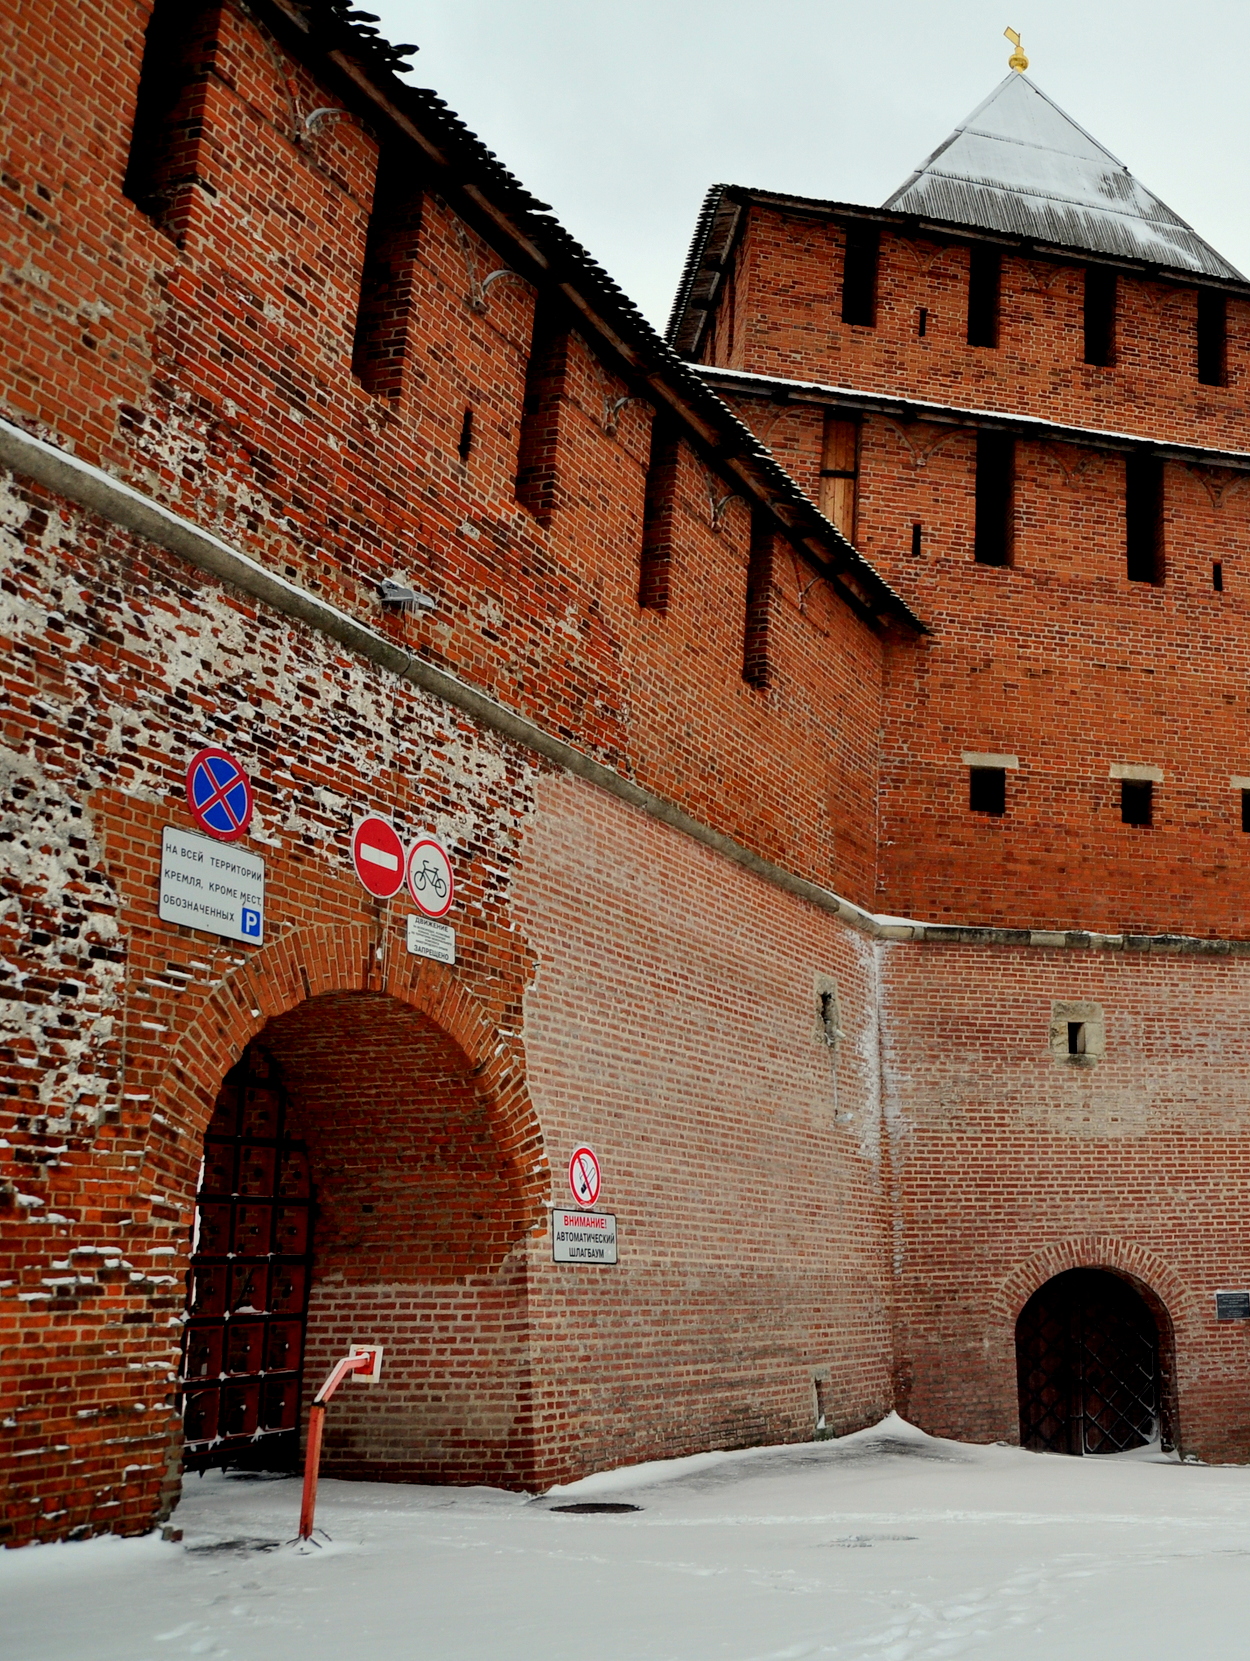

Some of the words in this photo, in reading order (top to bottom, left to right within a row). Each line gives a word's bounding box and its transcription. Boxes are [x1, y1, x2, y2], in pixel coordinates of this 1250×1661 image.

[165, 843, 178, 855] НА
[180, 848, 204, 863] ВСЕЙ
[210, 856, 262, 882] ТЕРРИТОРИИ
[164, 869, 204, 889] КРЕМЛЯ,
[208, 882, 238, 899] КРОМЕ
[163, 894, 235, 922] ОБОЗНАЧЕННЫХ
[415, 917, 449, 932] ДВИЖЕНИЕ
[413, 944, 449, 960] ЗАПРЕЩЕНО
[563, 1215, 607, 1229] ВНИМАНИЕ!
[556, 1231, 615, 1244] АВТОМАТИЧЕСКИЙ
[569, 1247, 605, 1258] ШЛАГБАУМ
